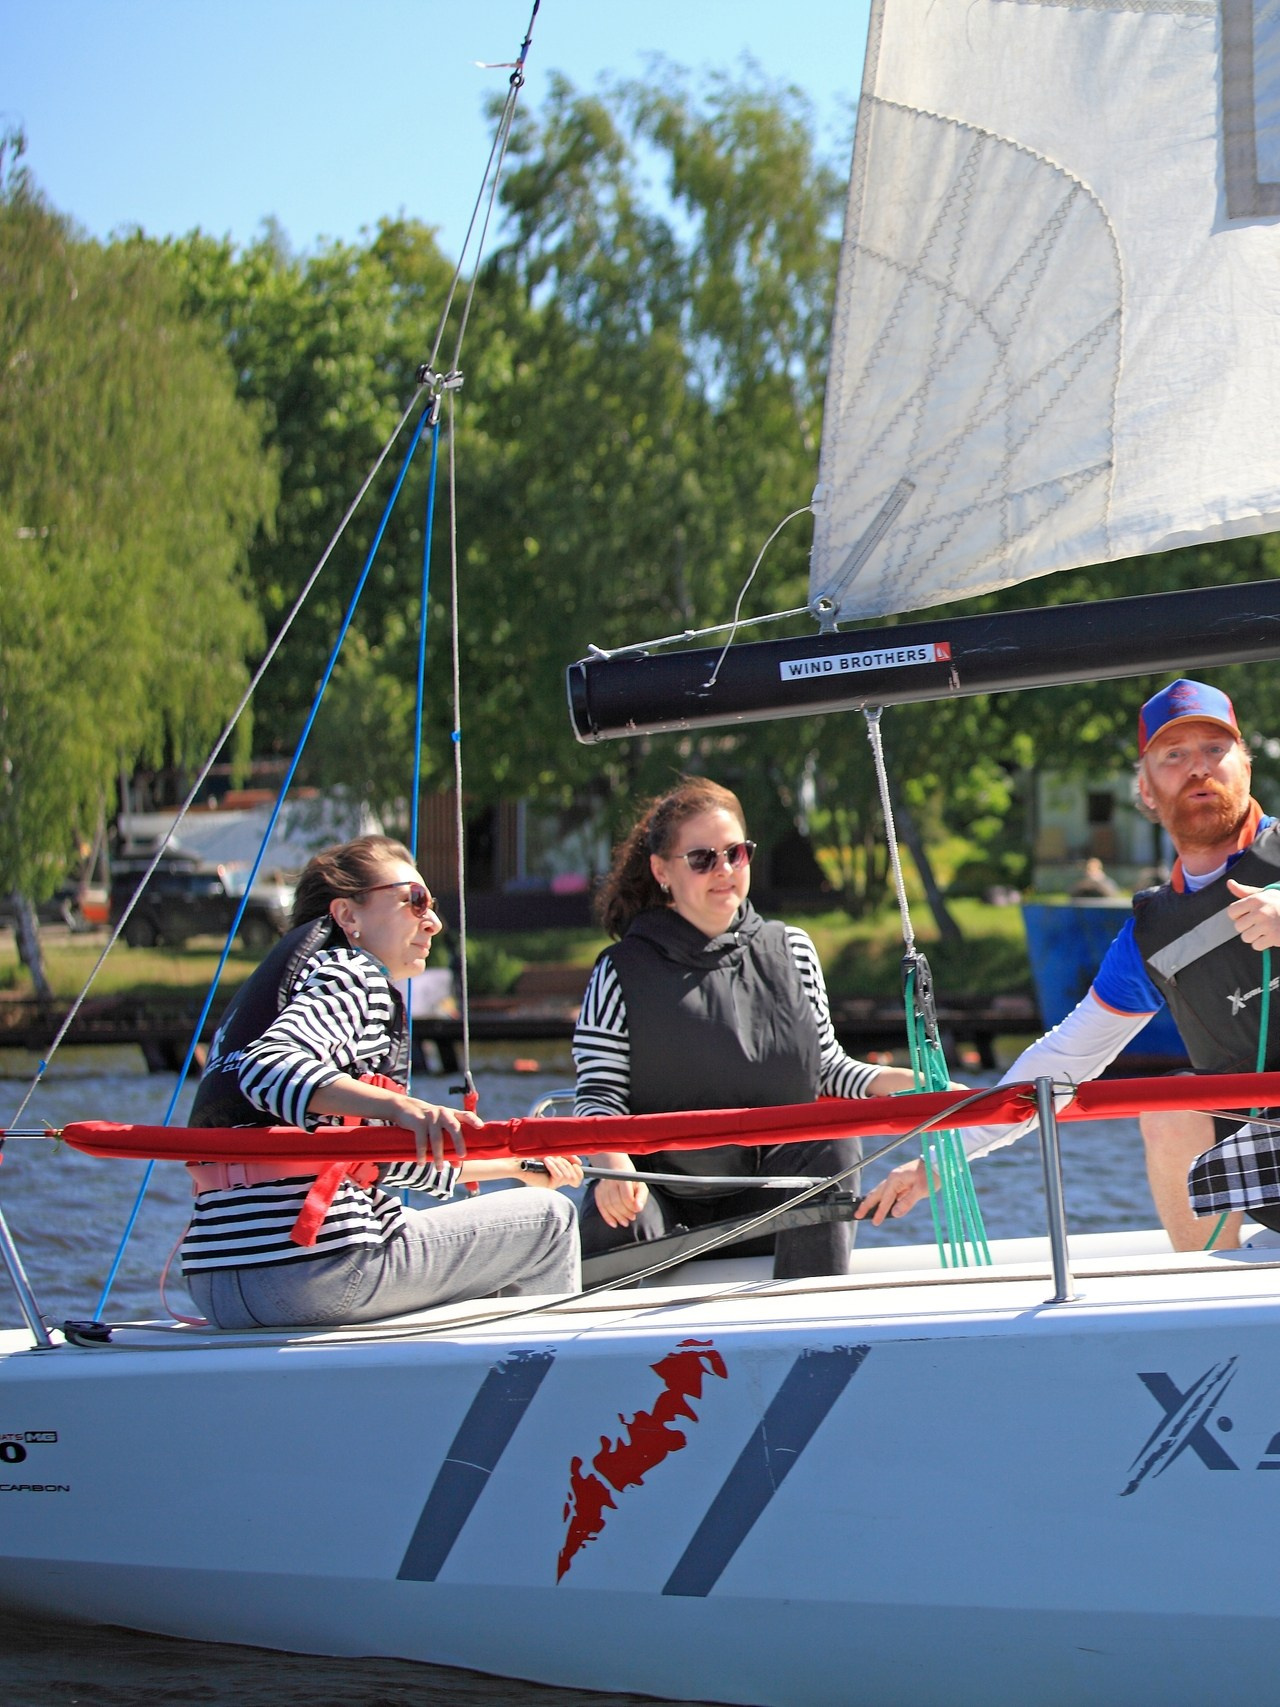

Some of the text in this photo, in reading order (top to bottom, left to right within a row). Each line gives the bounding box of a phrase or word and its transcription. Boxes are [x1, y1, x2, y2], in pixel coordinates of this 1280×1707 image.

[788, 648, 928, 676] WIND BROTHERS
[0, 1484, 70, 1492] CARBON
